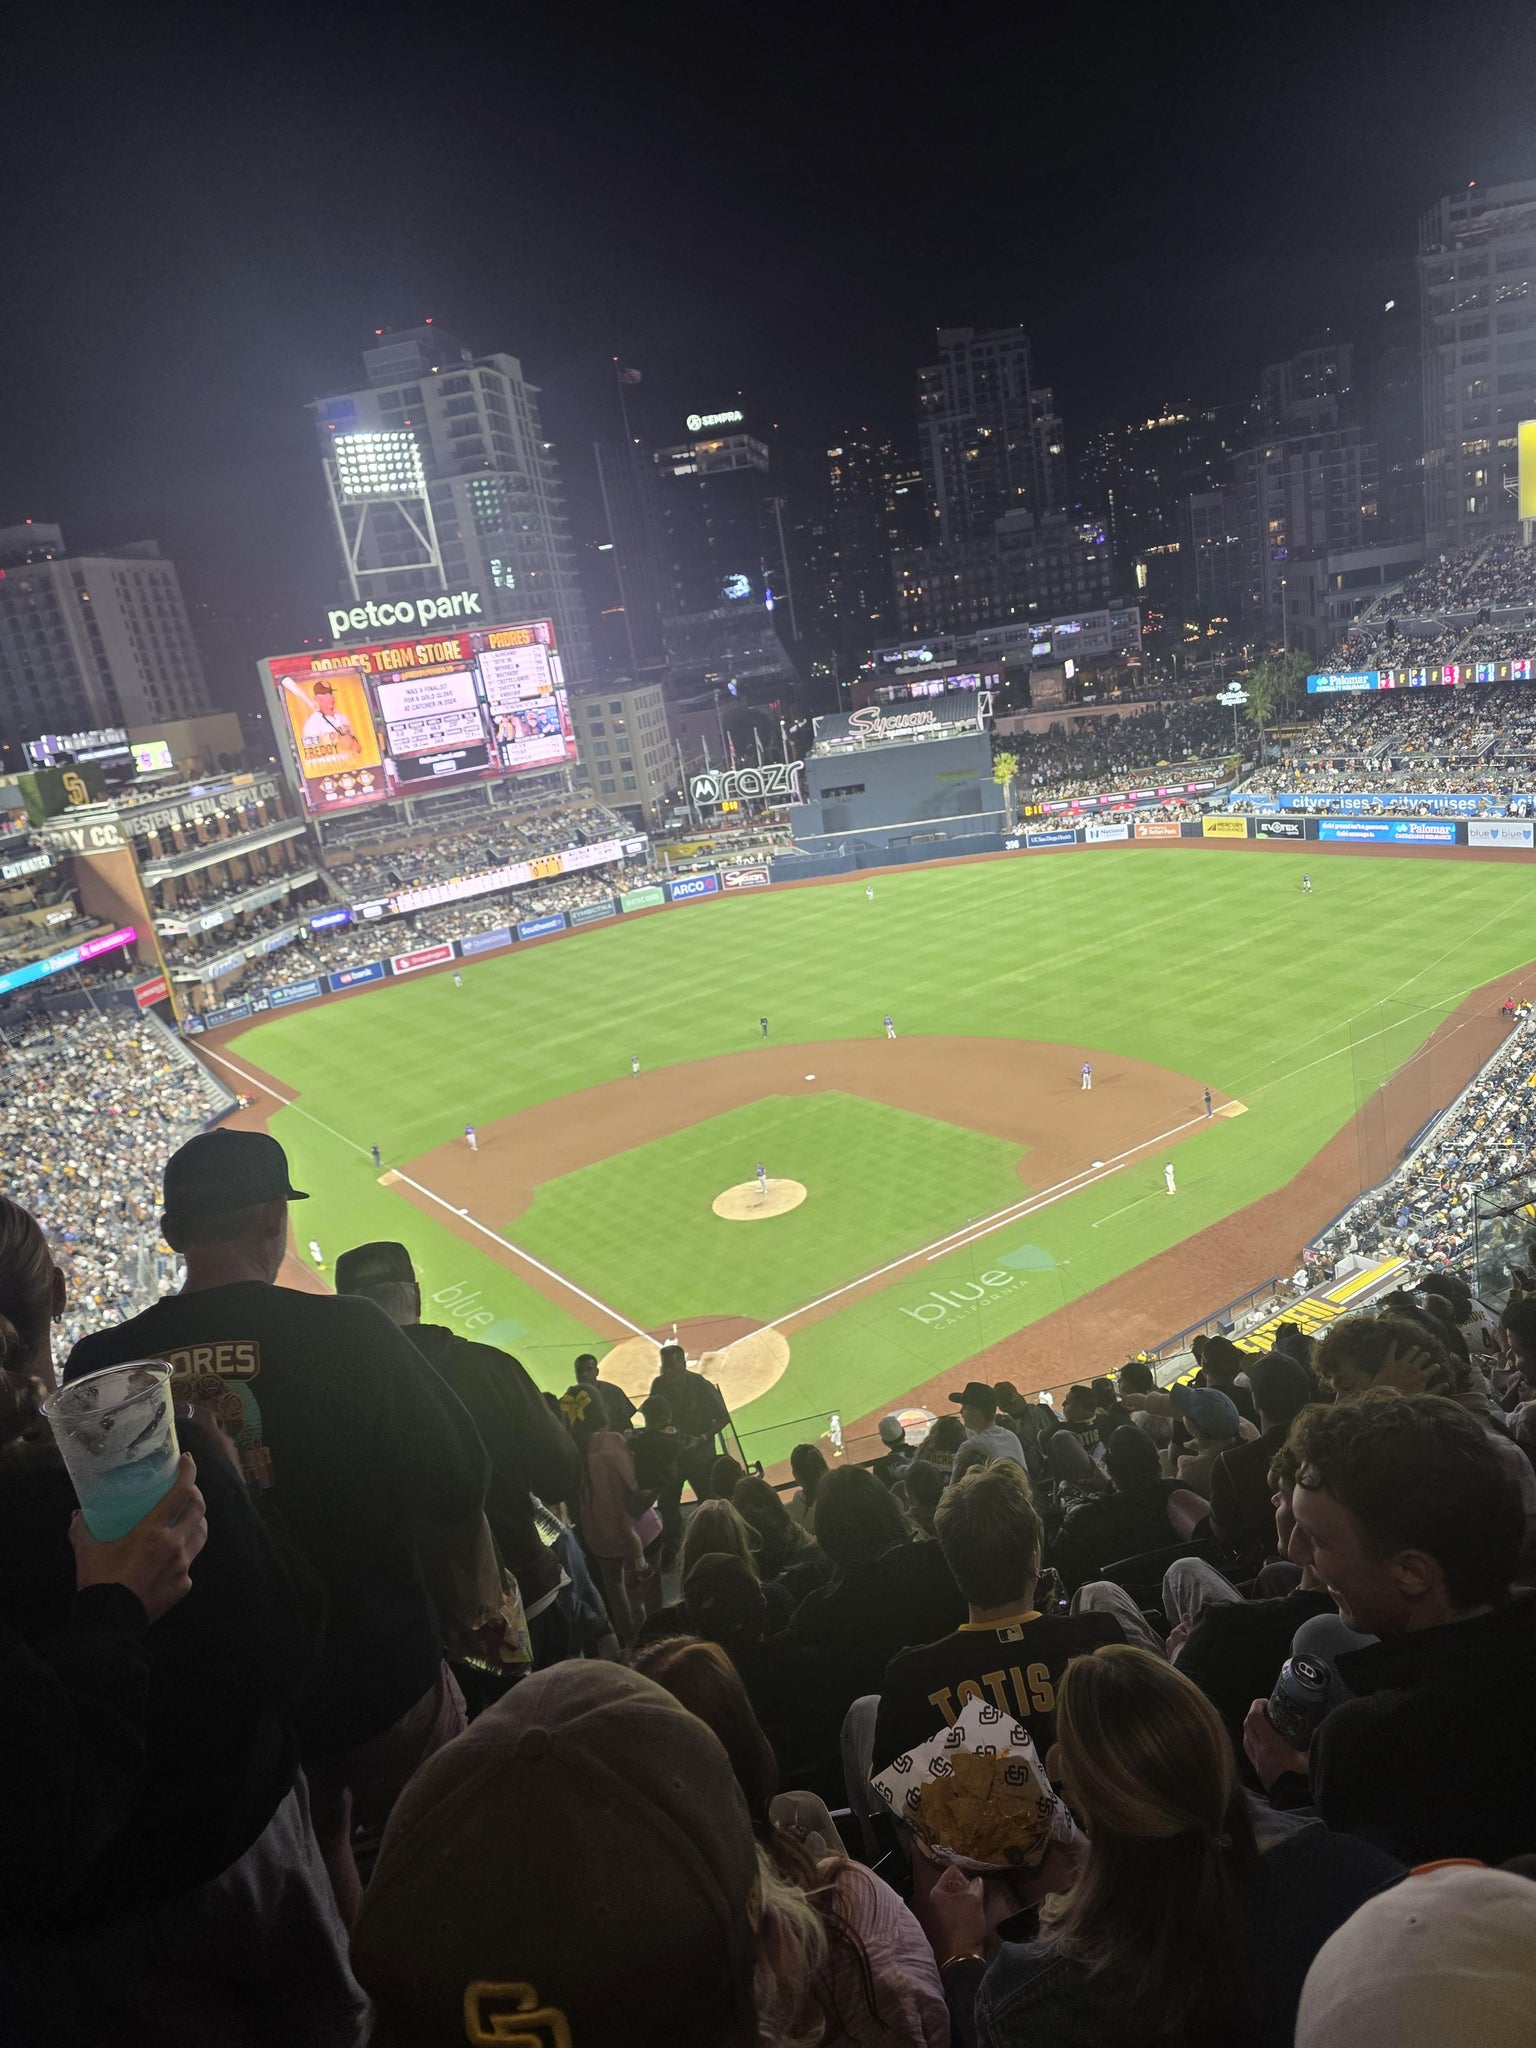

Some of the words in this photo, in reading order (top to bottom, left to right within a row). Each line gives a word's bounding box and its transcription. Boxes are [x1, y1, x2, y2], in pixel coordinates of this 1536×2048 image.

[702, 410, 743, 426] SEMPRA
[328, 600, 415, 639] petco
[416, 591, 482, 627] park
[488, 629, 531, 649] PADRES
[373, 647, 415, 671] TEAM
[415, 639, 463, 666] STORE
[1329, 675, 1369, 686] Palomar
[849, 706, 937, 739] Sycuan
[303, 743, 339, 759] FREDDY
[720, 760, 804, 798] razr
[124, 808, 181, 838] WESTERN
[182, 800, 217, 821] METAL
[219, 788, 260, 811] SUPPLY
[260, 782, 280, 800] CO.
[1292, 795, 1370, 810] citycrises
[1101, 827, 1125, 835] National
[1261, 821, 1299, 833] EVOTEK
[1409, 823, 1451, 834] Palomar
[1470, 828, 1489, 837] blue
[1502, 829, 1521, 838] blue
[89, 824, 126, 848] CO.
[673, 880, 705, 897] ARCO
[626, 893, 659, 907] dexcom
[521, 920, 557, 936] Southwest
[351, 968, 373, 980] bank
[899, 1270, 1014, 1324] blue
[934, 1279, 1030, 1330] CALIFORNIA
[430, 1281, 495, 1330] blue
[173, 1343, 256, 1379] DRES
